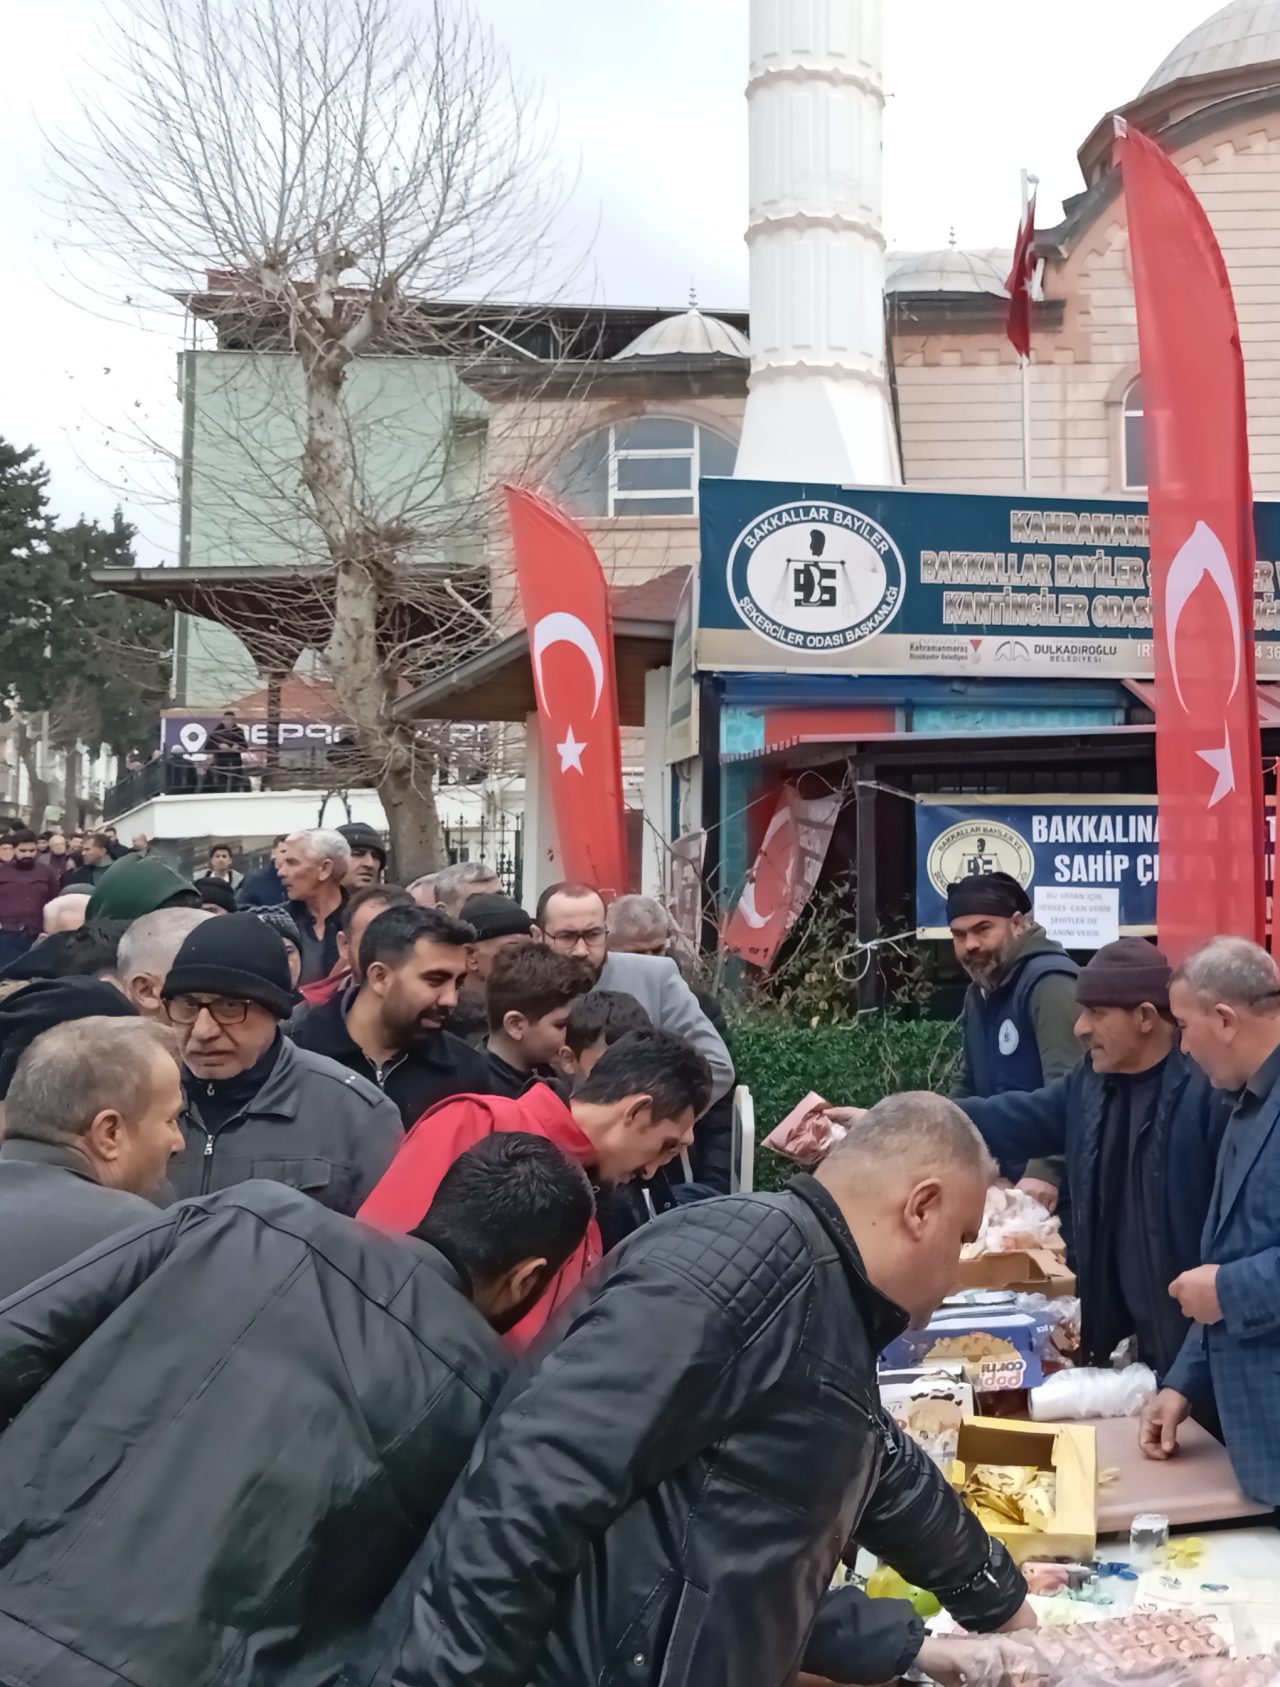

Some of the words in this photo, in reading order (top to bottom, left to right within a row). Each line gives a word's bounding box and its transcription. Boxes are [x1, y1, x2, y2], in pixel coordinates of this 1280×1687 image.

[743, 507, 829, 549] BAKKALLAR
[833, 510, 890, 554] BAYİLER
[1010, 509, 1149, 547] KAHRAMAN
[920, 550, 1052, 586] BAKKALLAR
[1054, 548, 1145, 589] BAYİLER
[806, 632, 845, 648] ODASI
[845, 586, 899, 643] BAŞKANLIĞI
[943, 586, 1090, 627] KANTİNCİLER
[1054, 850, 1129, 883] SAHİP
